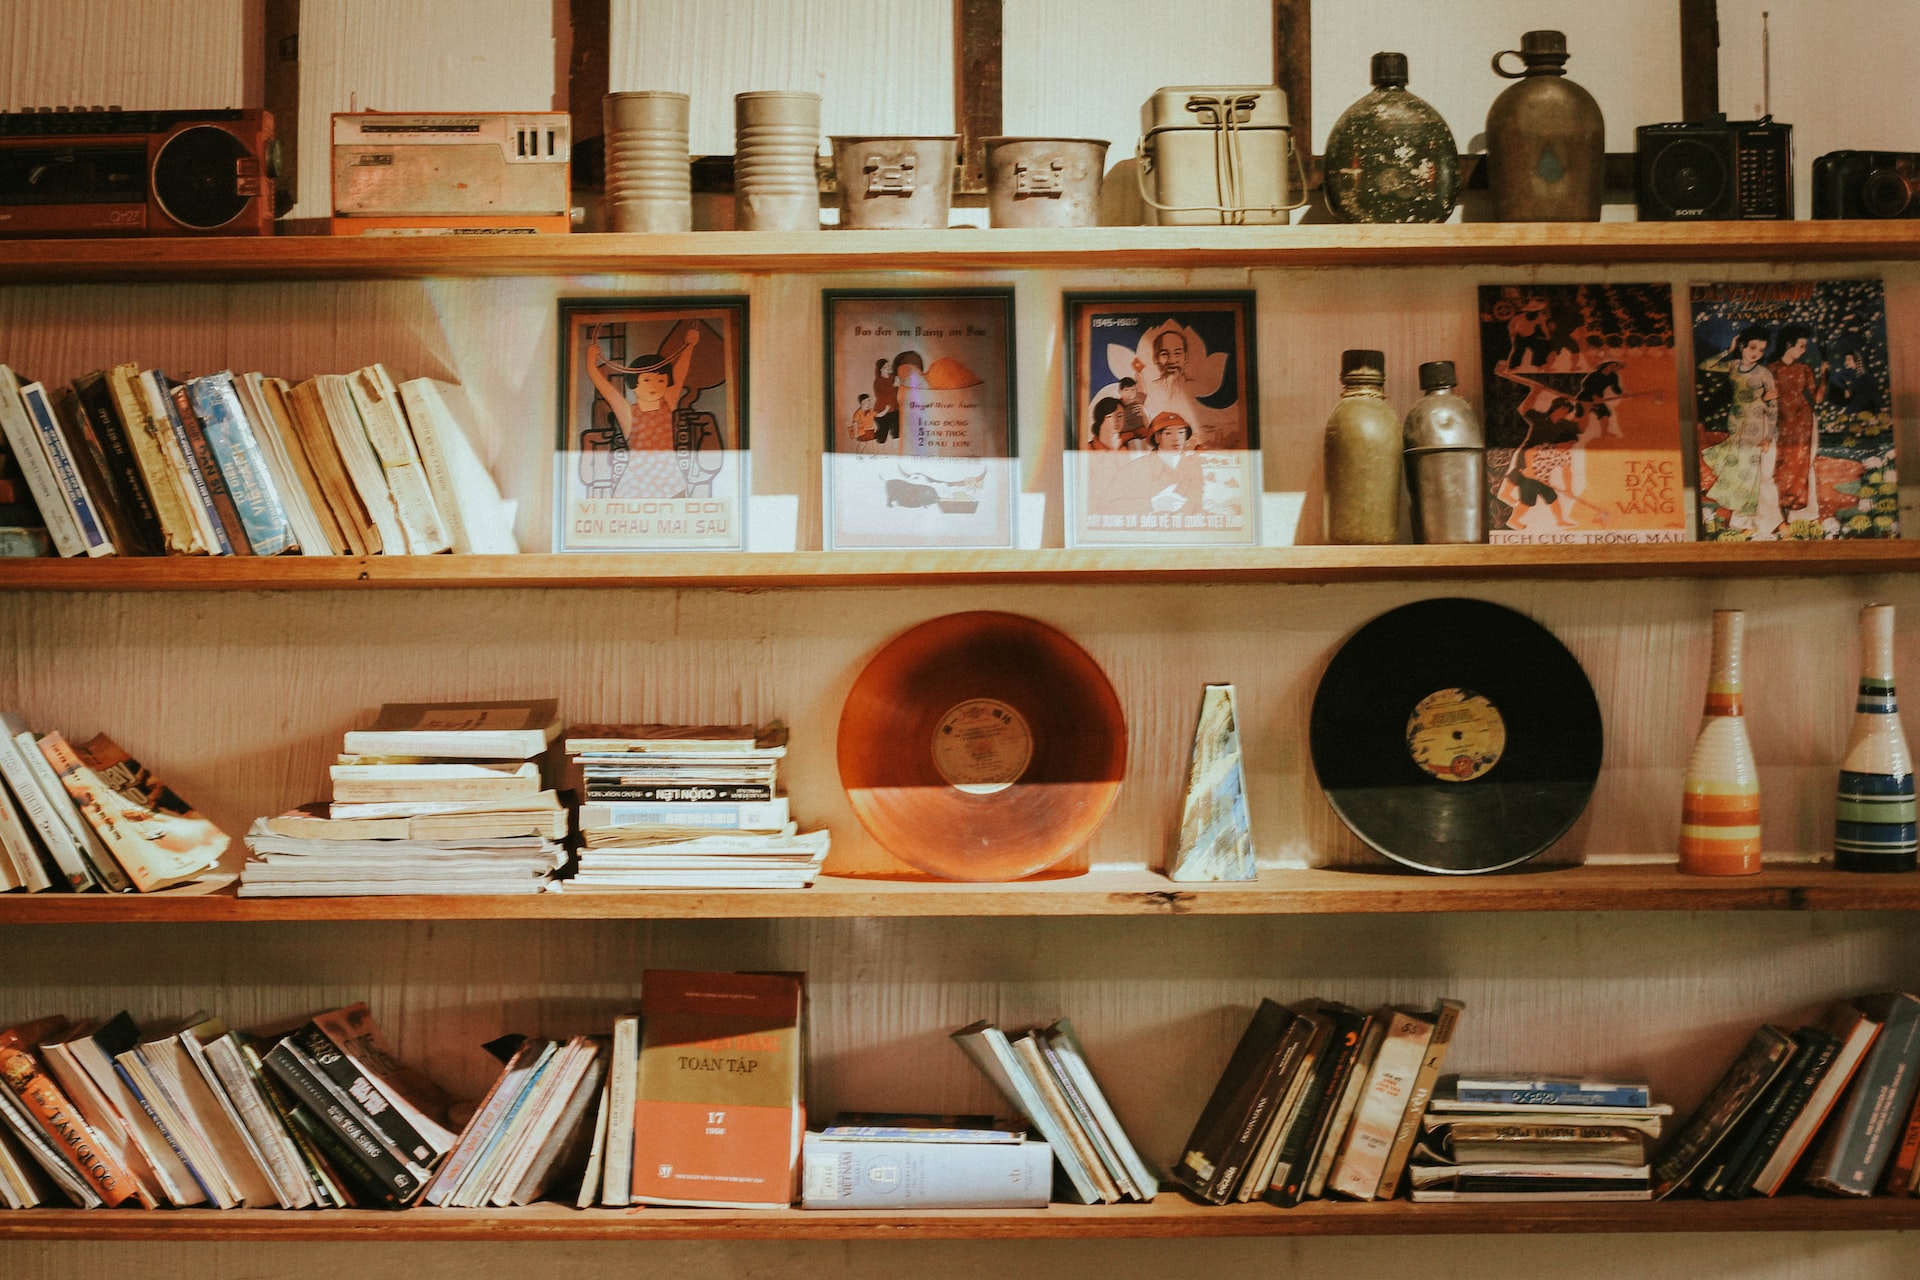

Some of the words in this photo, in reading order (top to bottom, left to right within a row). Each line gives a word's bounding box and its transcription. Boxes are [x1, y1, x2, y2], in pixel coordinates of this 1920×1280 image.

[1675, 208, 1704, 216] SONY
[575, 519, 604, 534] CON
[657, 519, 688, 534] MAI
[695, 519, 728, 534] SAU
[706, 1111, 727, 1124] 17
